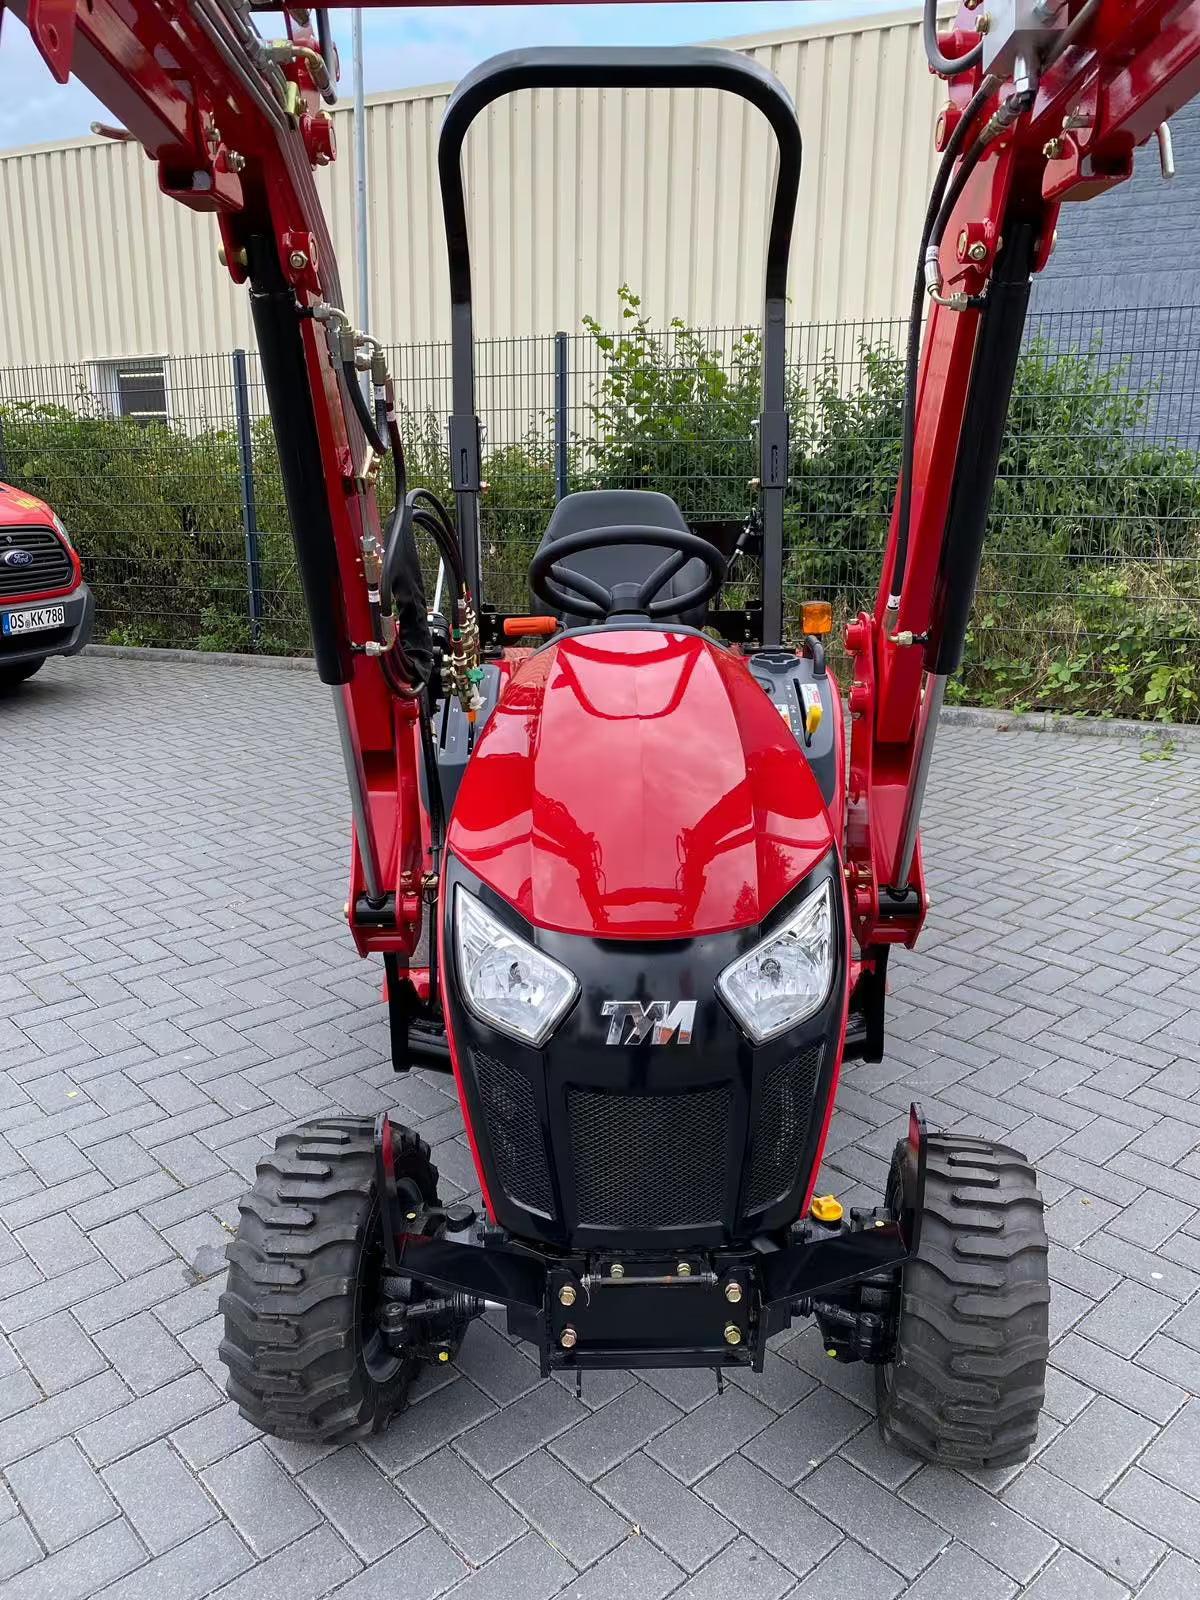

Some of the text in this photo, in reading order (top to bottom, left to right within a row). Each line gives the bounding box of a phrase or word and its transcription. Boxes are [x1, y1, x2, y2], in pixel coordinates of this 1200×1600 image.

[13, 553, 29, 564] Ford
[10, 607, 64, 629] OS KK 788
[601, 1001, 698, 1046] TYM
